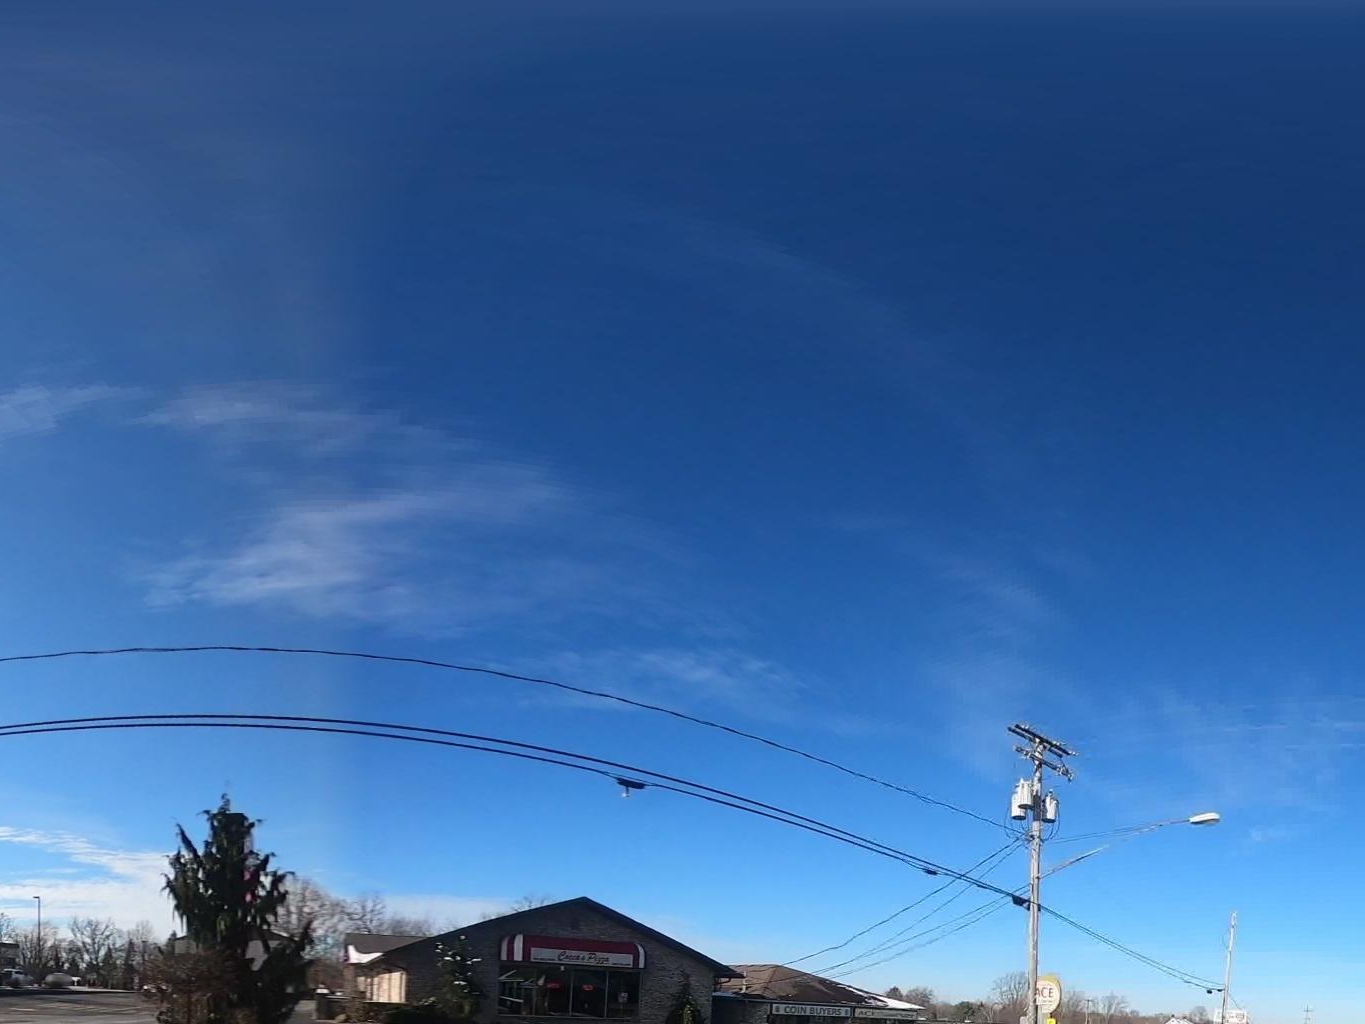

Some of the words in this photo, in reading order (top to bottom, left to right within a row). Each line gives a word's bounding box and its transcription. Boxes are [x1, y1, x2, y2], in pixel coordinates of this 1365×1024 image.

[587, 953, 610, 964] Pizza
[784, 1006, 807, 1014] COIN
[809, 1007, 842, 1016] BUYERS
